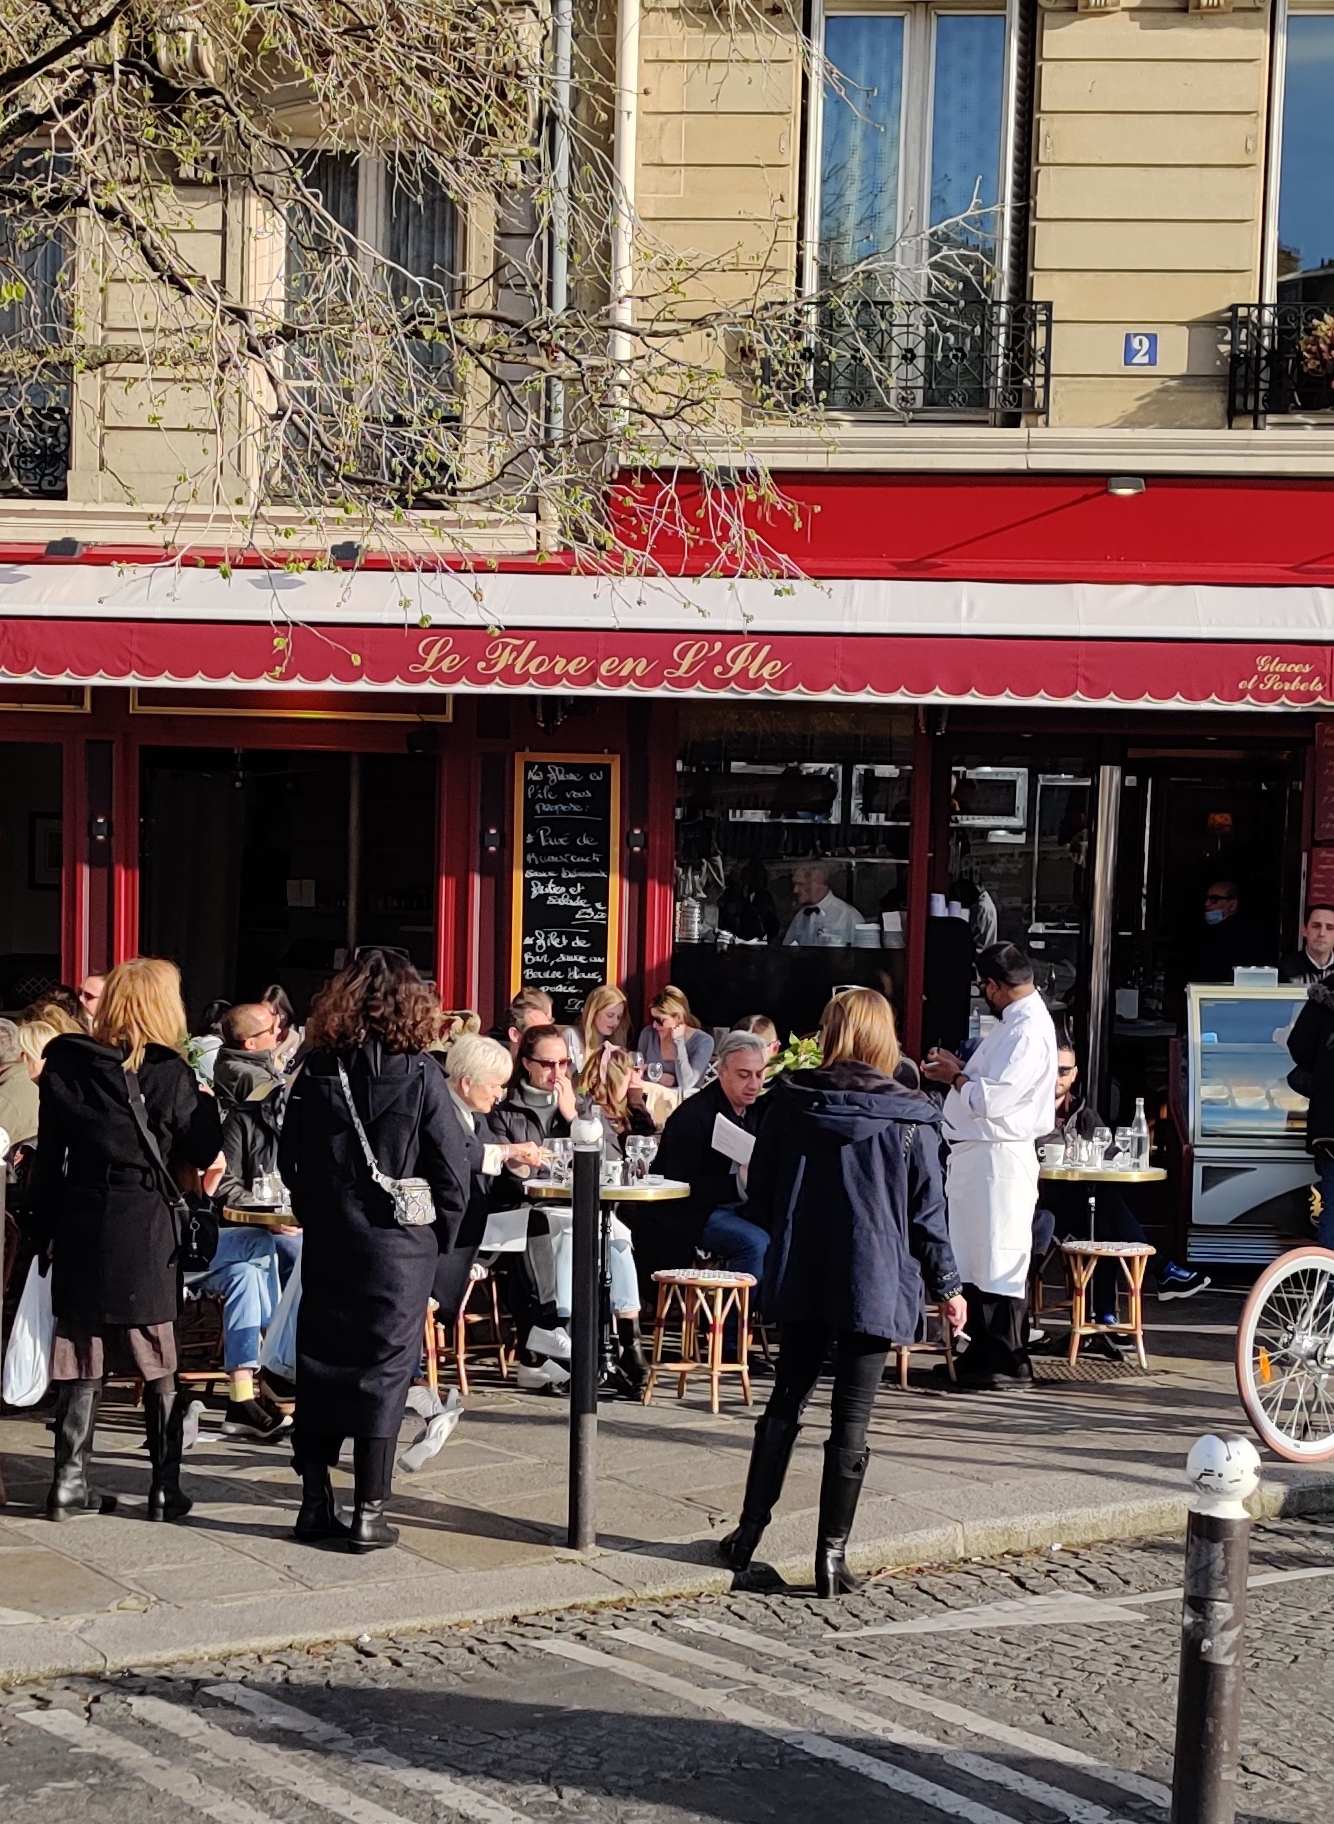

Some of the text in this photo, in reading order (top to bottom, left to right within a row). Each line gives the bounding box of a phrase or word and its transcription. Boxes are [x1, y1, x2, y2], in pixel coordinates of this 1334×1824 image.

[1132, 335, 1149, 363] 2
[409, 636, 792, 680] Le Flore en L'Ile
[1255, 655, 1315, 674] Glaces
[1238, 674, 1327, 692] et Sorbets
[566, 790, 592, 798] vous
[577, 833, 599, 845] de
[569, 882, 585, 894] et
[571, 936, 591, 947] de
